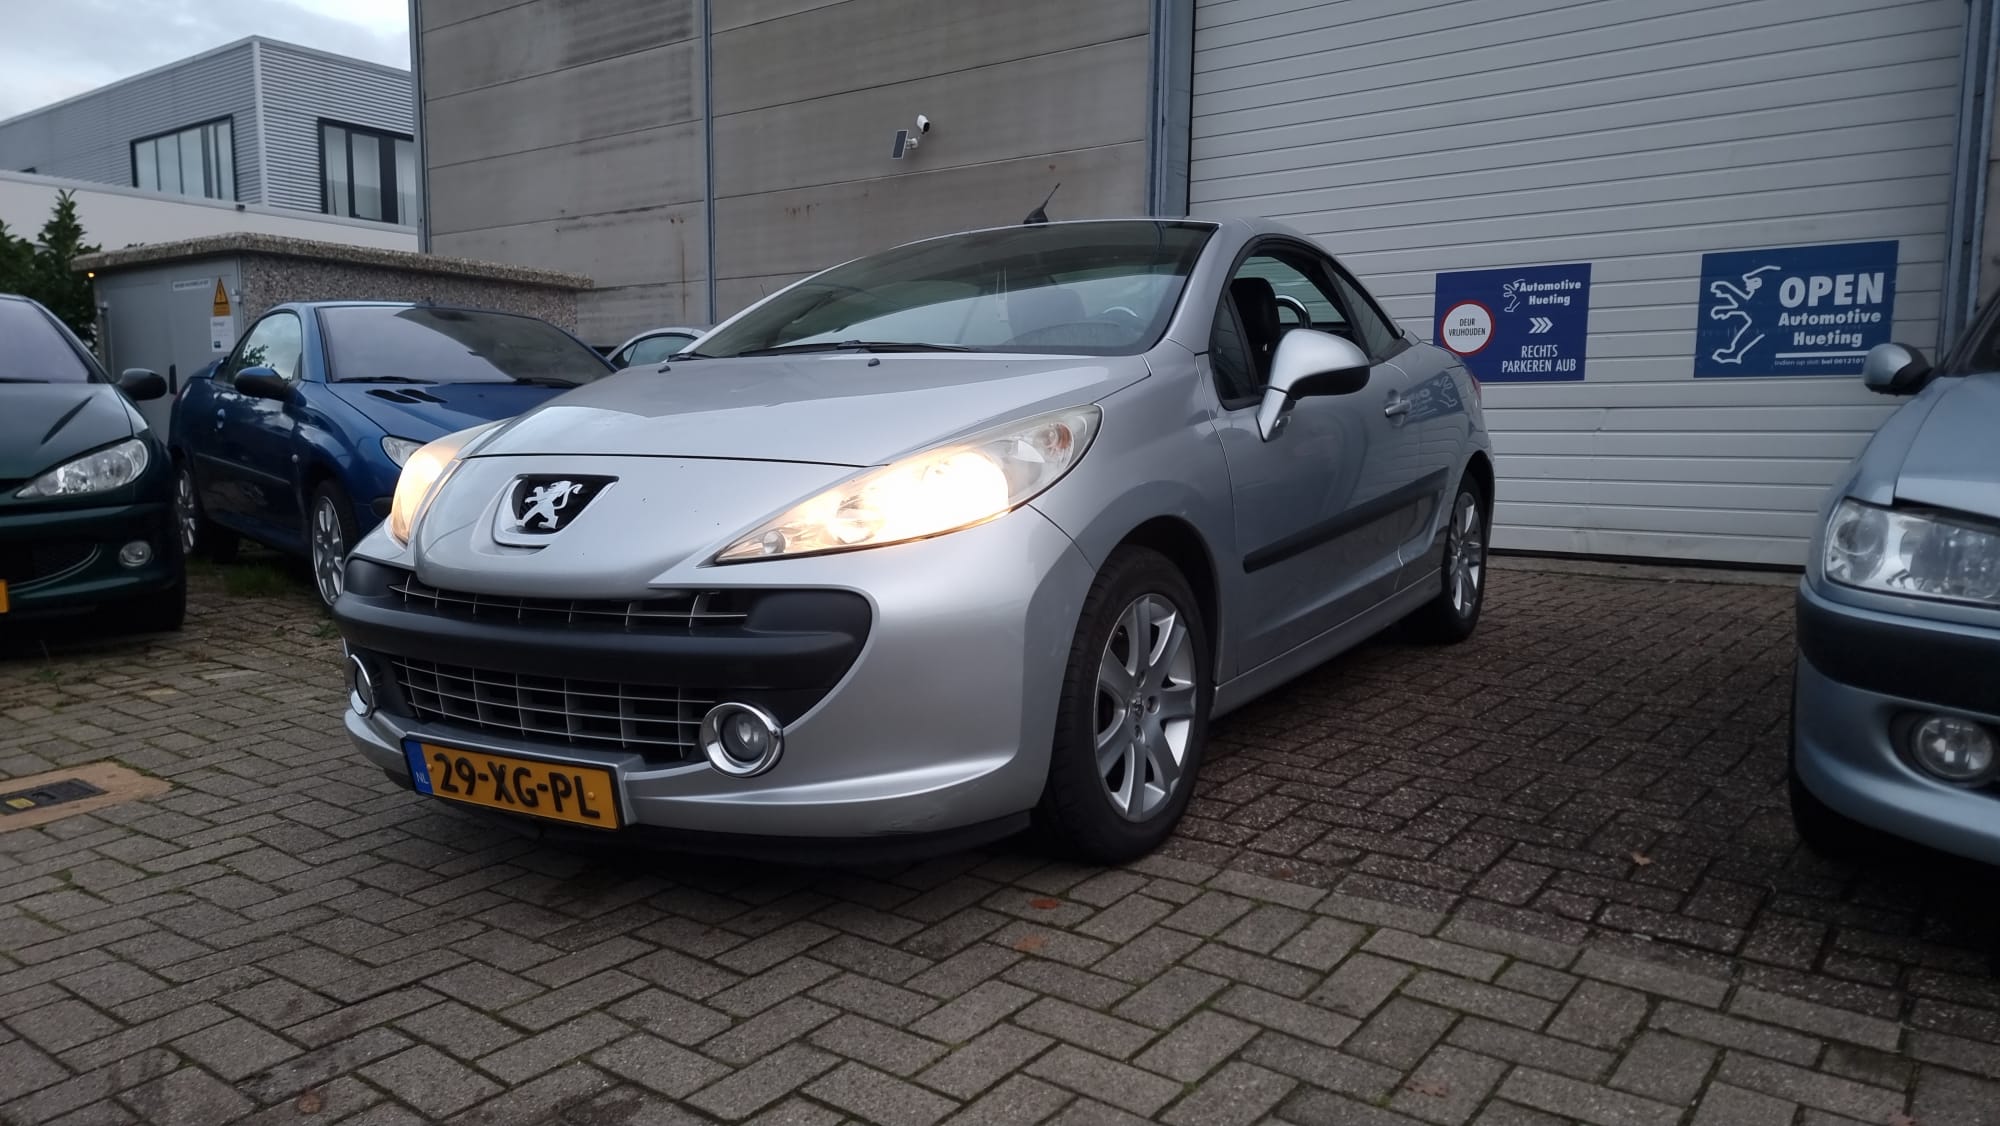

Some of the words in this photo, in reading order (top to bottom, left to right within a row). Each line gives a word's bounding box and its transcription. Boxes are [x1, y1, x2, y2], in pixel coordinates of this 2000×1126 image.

[1519, 279, 1582, 292] Automotive
[1778, 272, 1885, 308] OPEN
[1528, 295, 1571, 306] Hueting
[1459, 318, 1476, 327] DEUR
[1778, 308, 1882, 327] Automotive
[1793, 331, 1863, 348] Hueting
[1521, 344, 1559, 359] RECHTS
[1502, 359, 1552, 374] PARKEREN
[1556, 358, 1577, 372] AUB
[415, 772, 430, 785] NL
[433, 752, 601, 819] 29-XG-PL
